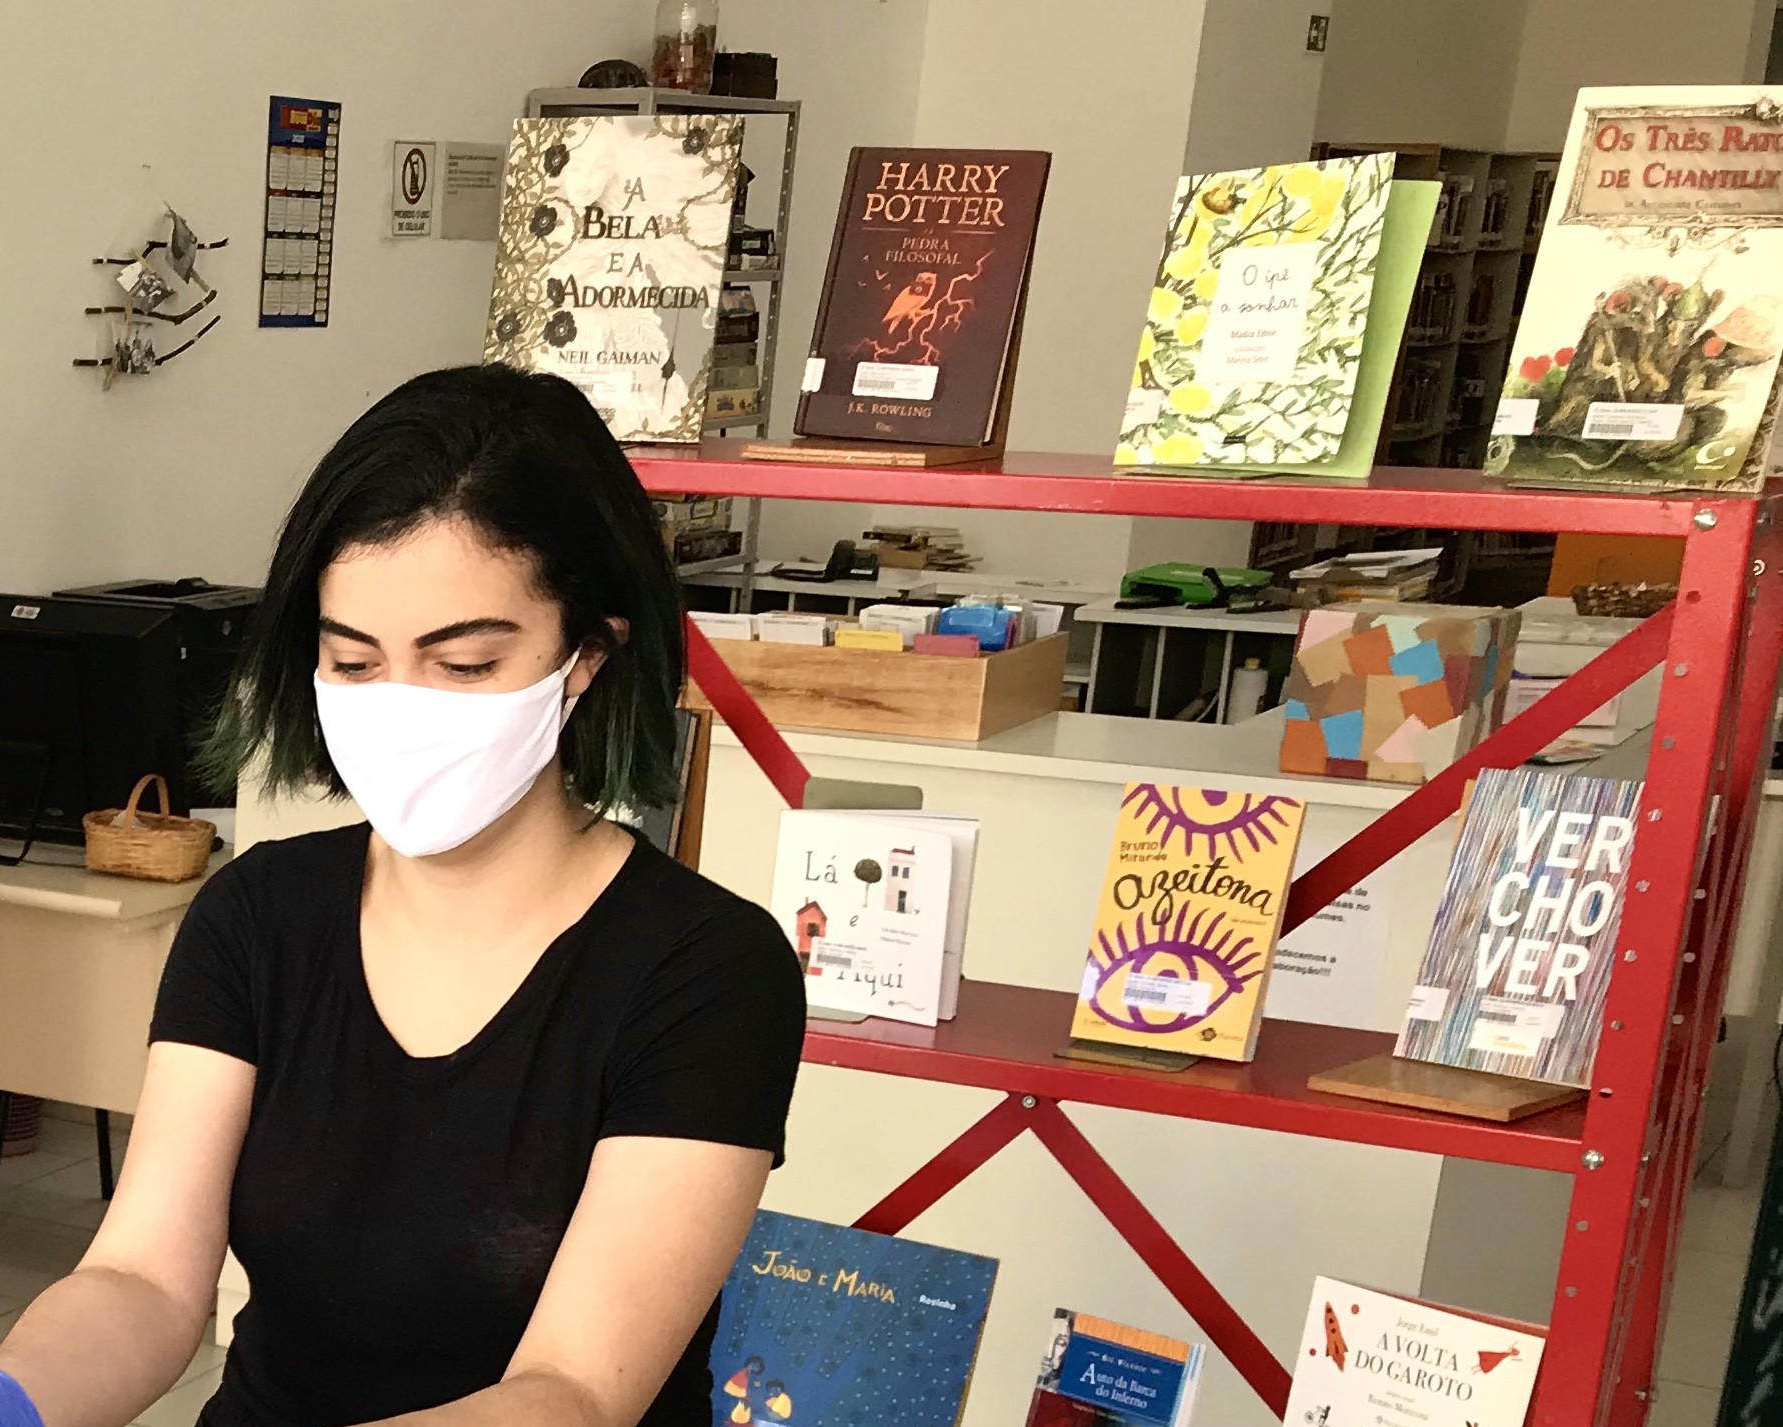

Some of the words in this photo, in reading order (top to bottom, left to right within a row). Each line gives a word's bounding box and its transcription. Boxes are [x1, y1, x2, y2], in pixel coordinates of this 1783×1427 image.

[1645, 125, 1711, 152] TRÊS
[876, 162, 1010, 194] HARRY
[1597, 168, 1630, 189] DE
[1642, 162, 1782, 190] CHANTILLY
[580, 205, 663, 240] BELA
[862, 193, 1005, 227] POTTER
[885, 250, 962, 265] FILOSOFAL
[902, 236, 949, 251] PEDRA
[606, 252, 624, 274] E
[625, 252, 644, 278] A
[1242, 263, 1259, 287] O
[561, 273, 710, 310] ADORMECIDA
[1220, 300, 1232, 314] a
[1238, 296, 1300, 315] sonhar
[557, 351, 592, 365] NEIL
[596, 351, 664, 366] GAIMAN
[871, 403, 933, 419] ROWLING
[1515, 806, 1634, 874] VER
[804, 849, 839, 884] Lá
[1112, 856, 1275, 926] azeitona
[1488, 870, 1617, 938] CHO
[849, 913, 860, 927] e
[1474, 932, 1592, 1001] VER
[1374, 1331, 1389, 1351] A
[1395, 1334, 1459, 1372] VOLTA
[1079, 1362, 1114, 1386] Auto
[1114, 1375, 1128, 1390] da
[1129, 1378, 1157, 1399] Barca
[1094, 1384, 1111, 1398] do
[1353, 1349, 1385, 1375] DO
[1386, 1360, 1474, 1402] GAROTO
